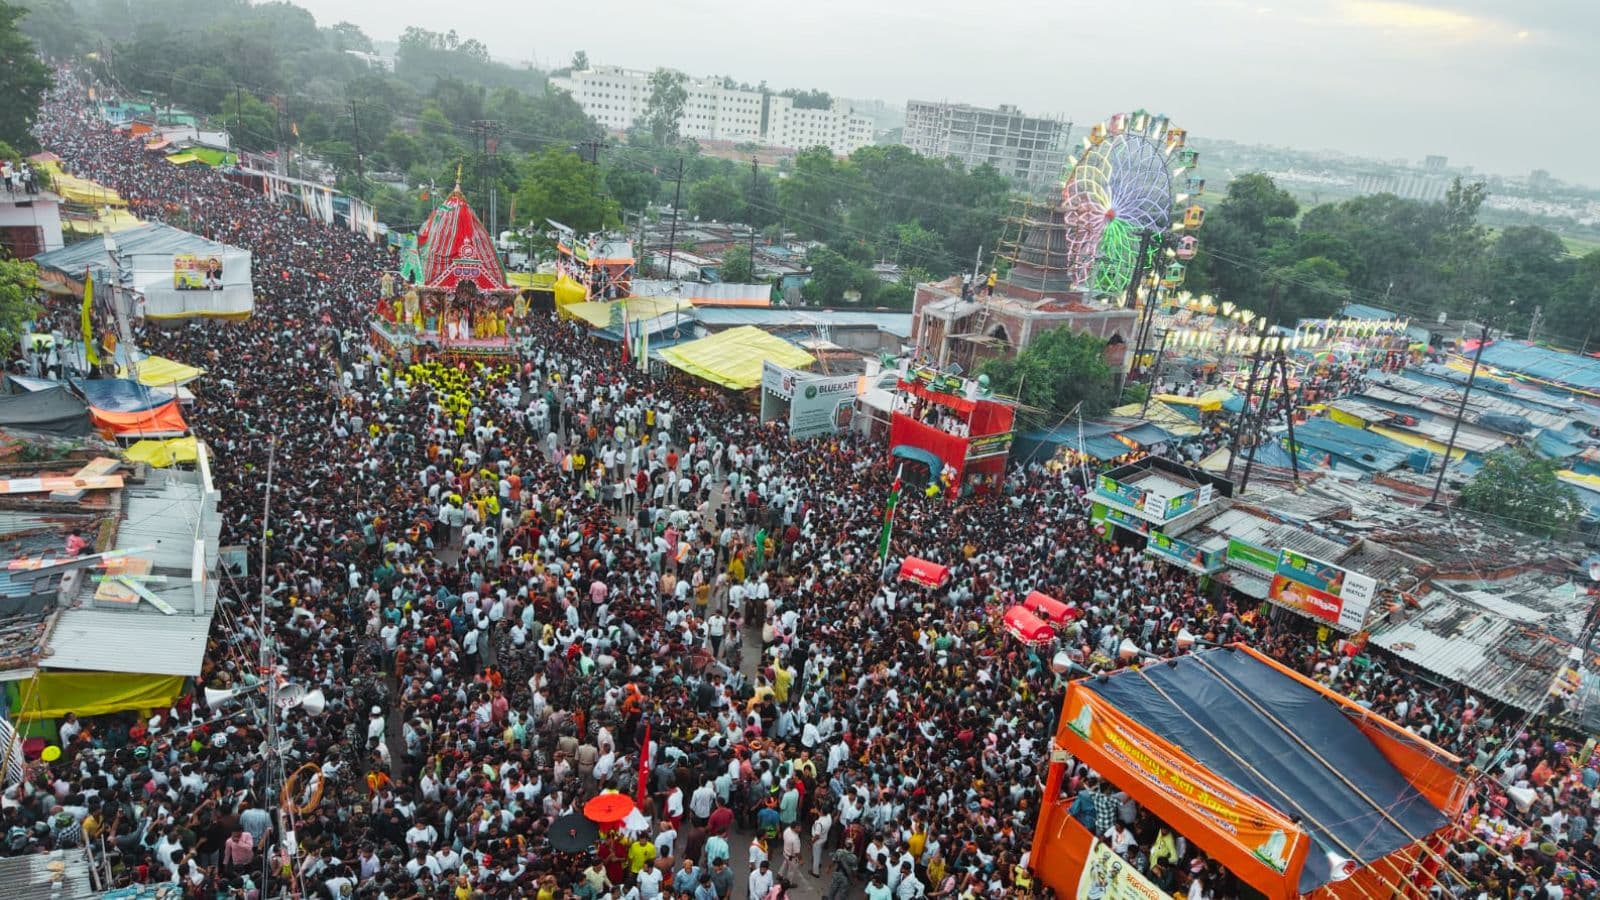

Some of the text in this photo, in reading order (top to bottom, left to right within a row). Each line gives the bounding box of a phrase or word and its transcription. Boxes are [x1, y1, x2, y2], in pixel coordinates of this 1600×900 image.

[819, 381, 858, 394] BLUEKART
[1348, 581, 1367, 591] PAPPU
[1345, 588, 1366, 598] WATCH
